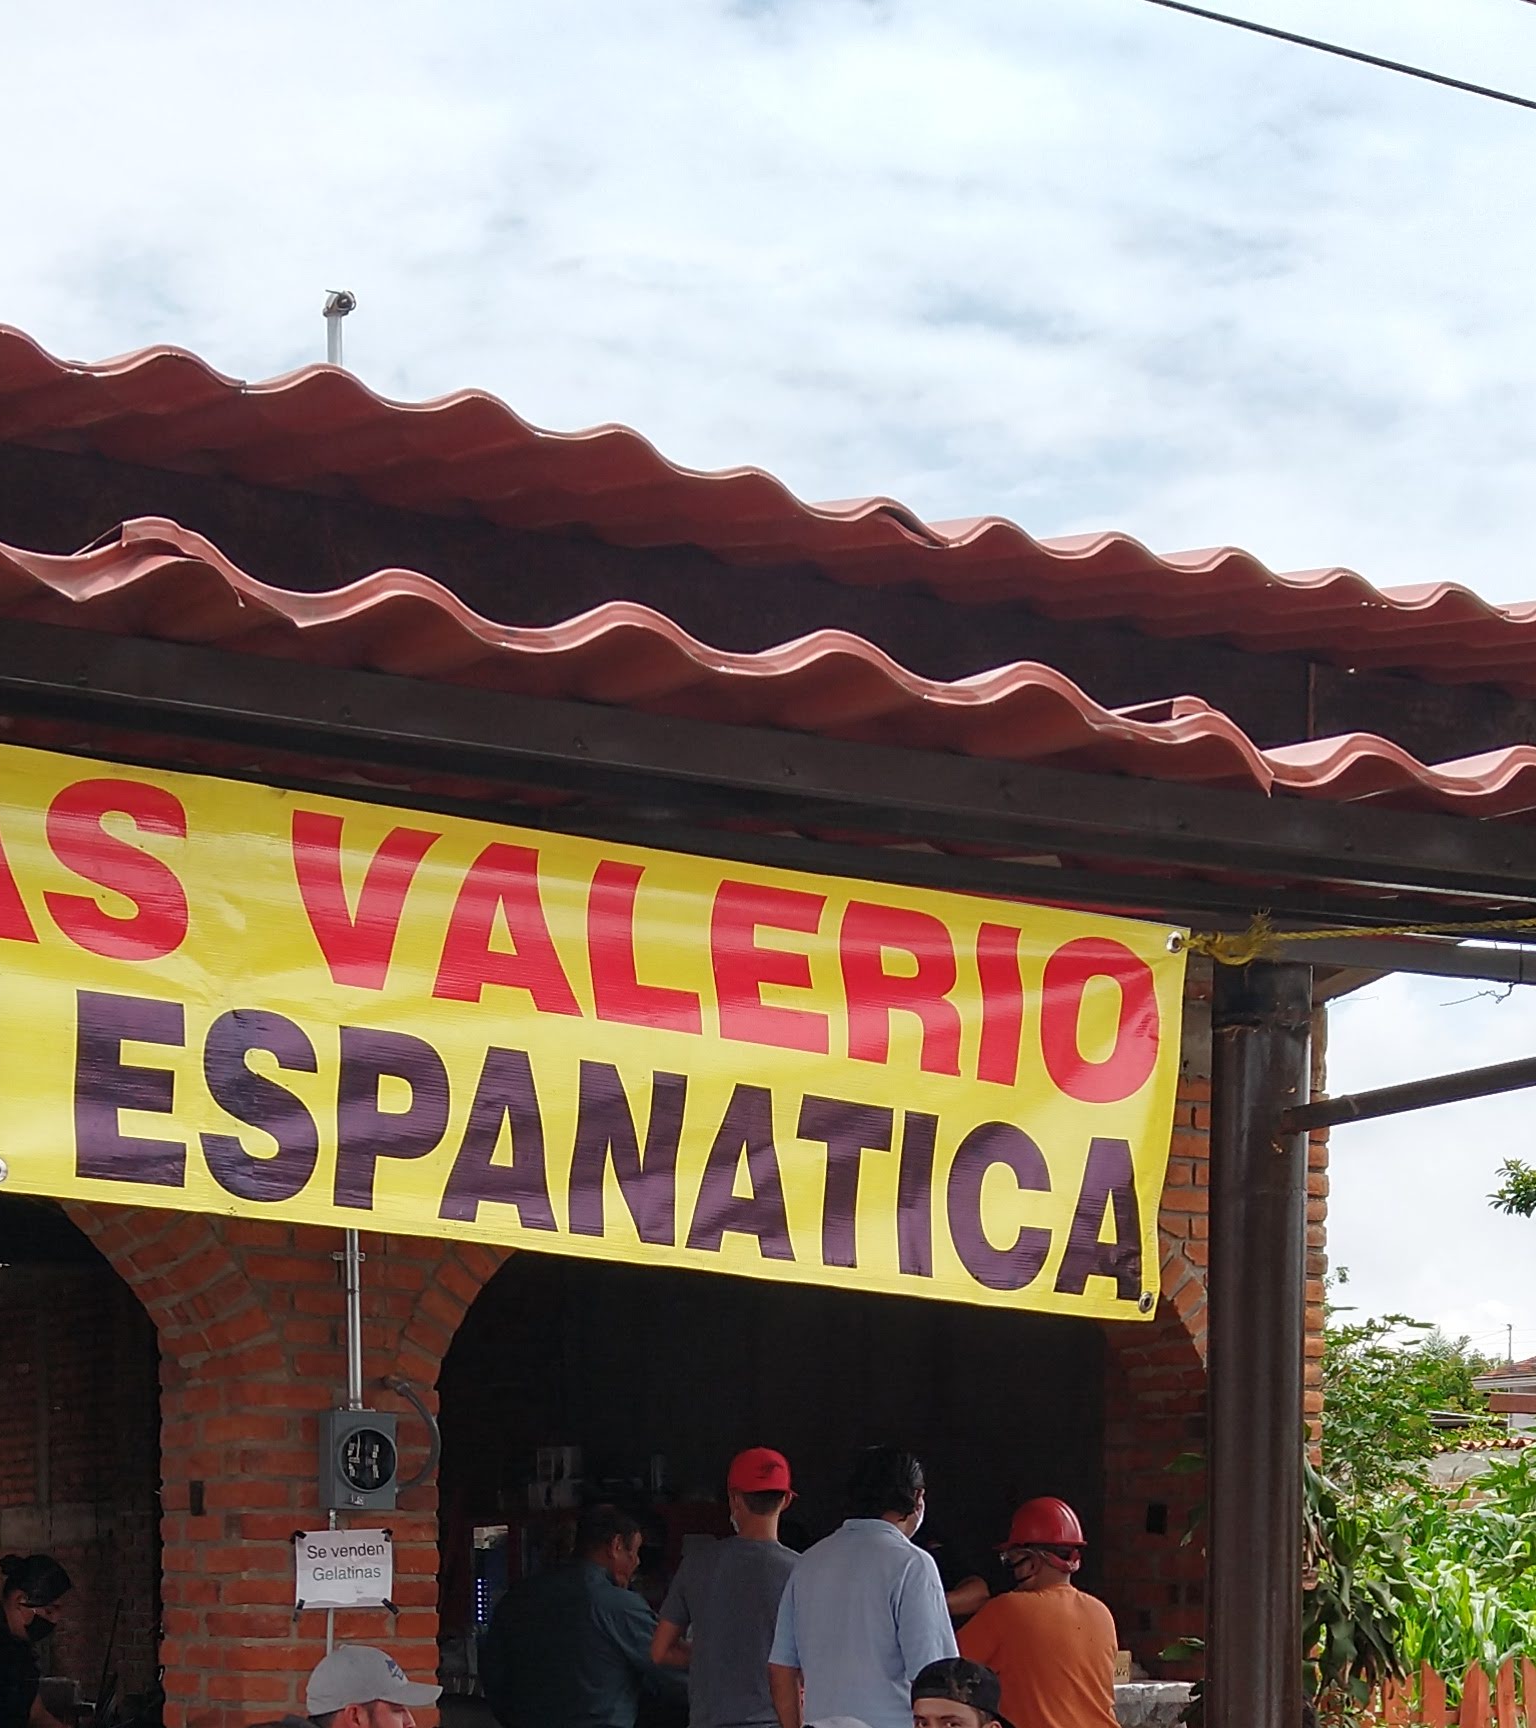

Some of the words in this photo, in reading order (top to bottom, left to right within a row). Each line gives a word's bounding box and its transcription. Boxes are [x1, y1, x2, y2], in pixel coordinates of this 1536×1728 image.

[290, 809, 1160, 1104] VALERIO
[74, 990, 1142, 1302] ESPANATICA
[306, 1545, 327, 1559] Se
[330, 1543, 385, 1558] venden
[312, 1566, 381, 1581] Gelatinas
